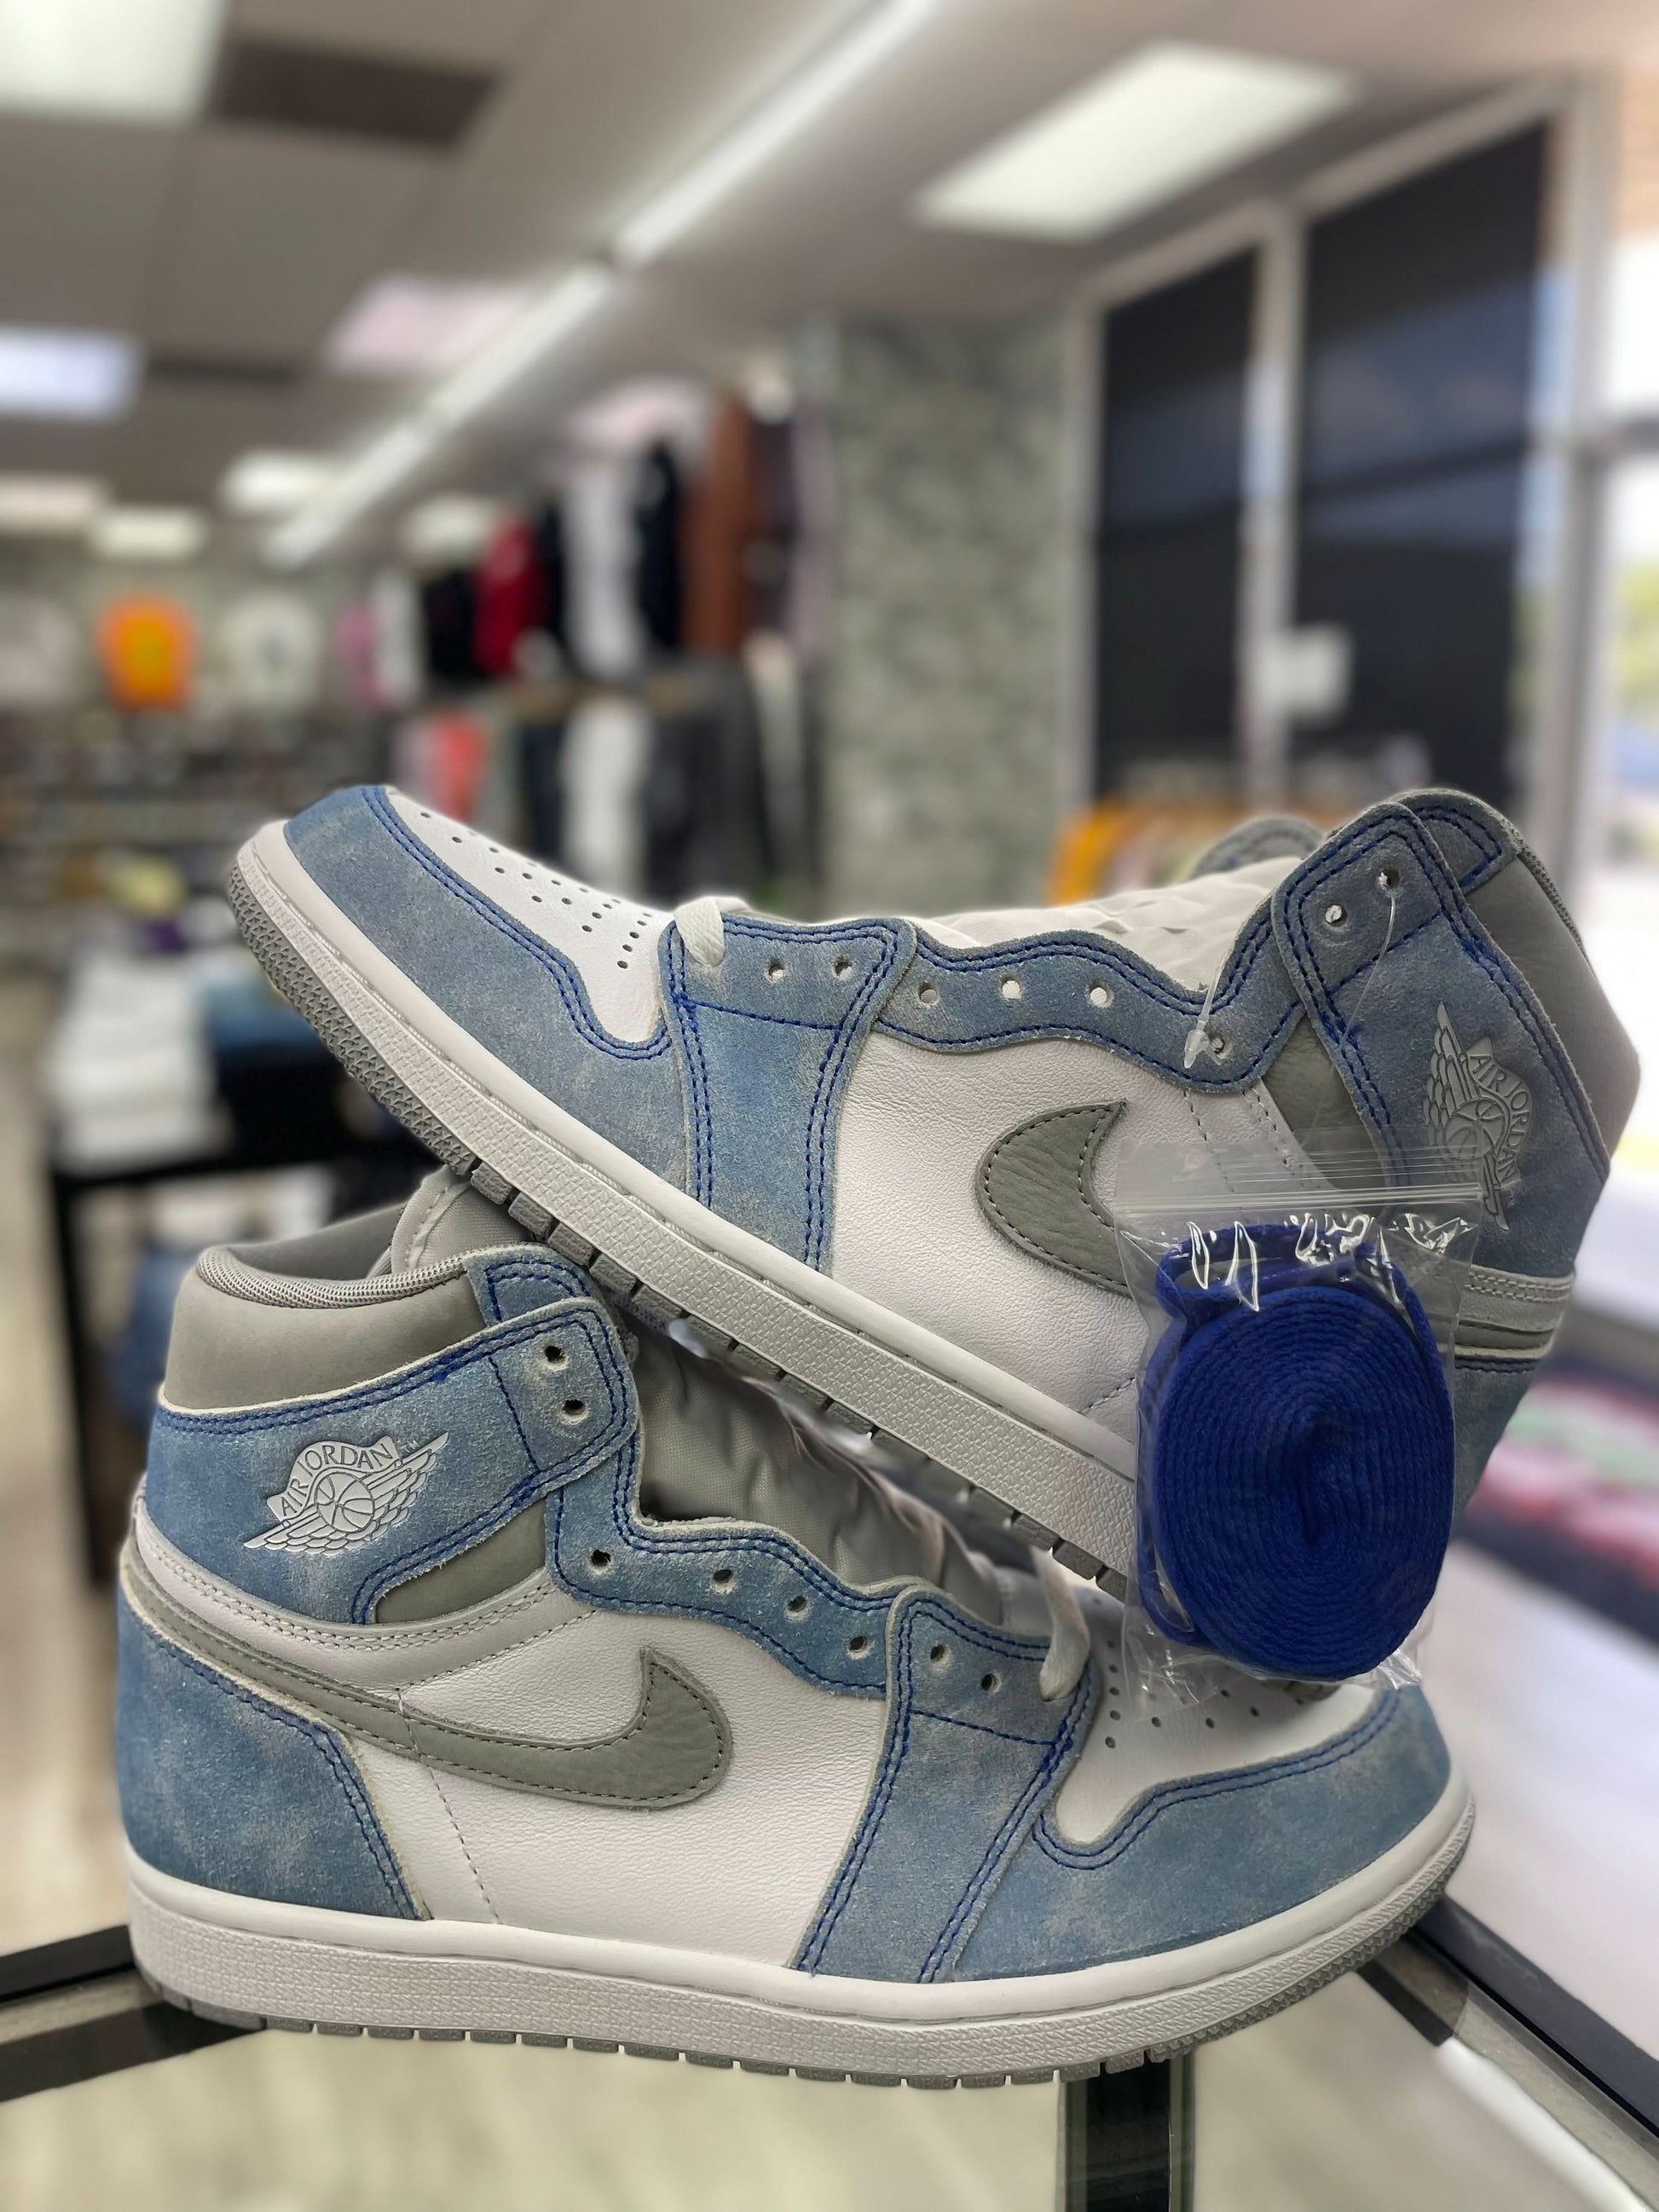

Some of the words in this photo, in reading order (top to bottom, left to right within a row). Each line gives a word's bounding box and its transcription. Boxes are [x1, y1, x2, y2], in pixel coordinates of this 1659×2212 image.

[1468, 1054, 1506, 1093] AIR
[1496, 1081, 1531, 1182] JORDAN
[280, 1479, 309, 1516] AIR
[297, 1443, 393, 1478] JORDAN
